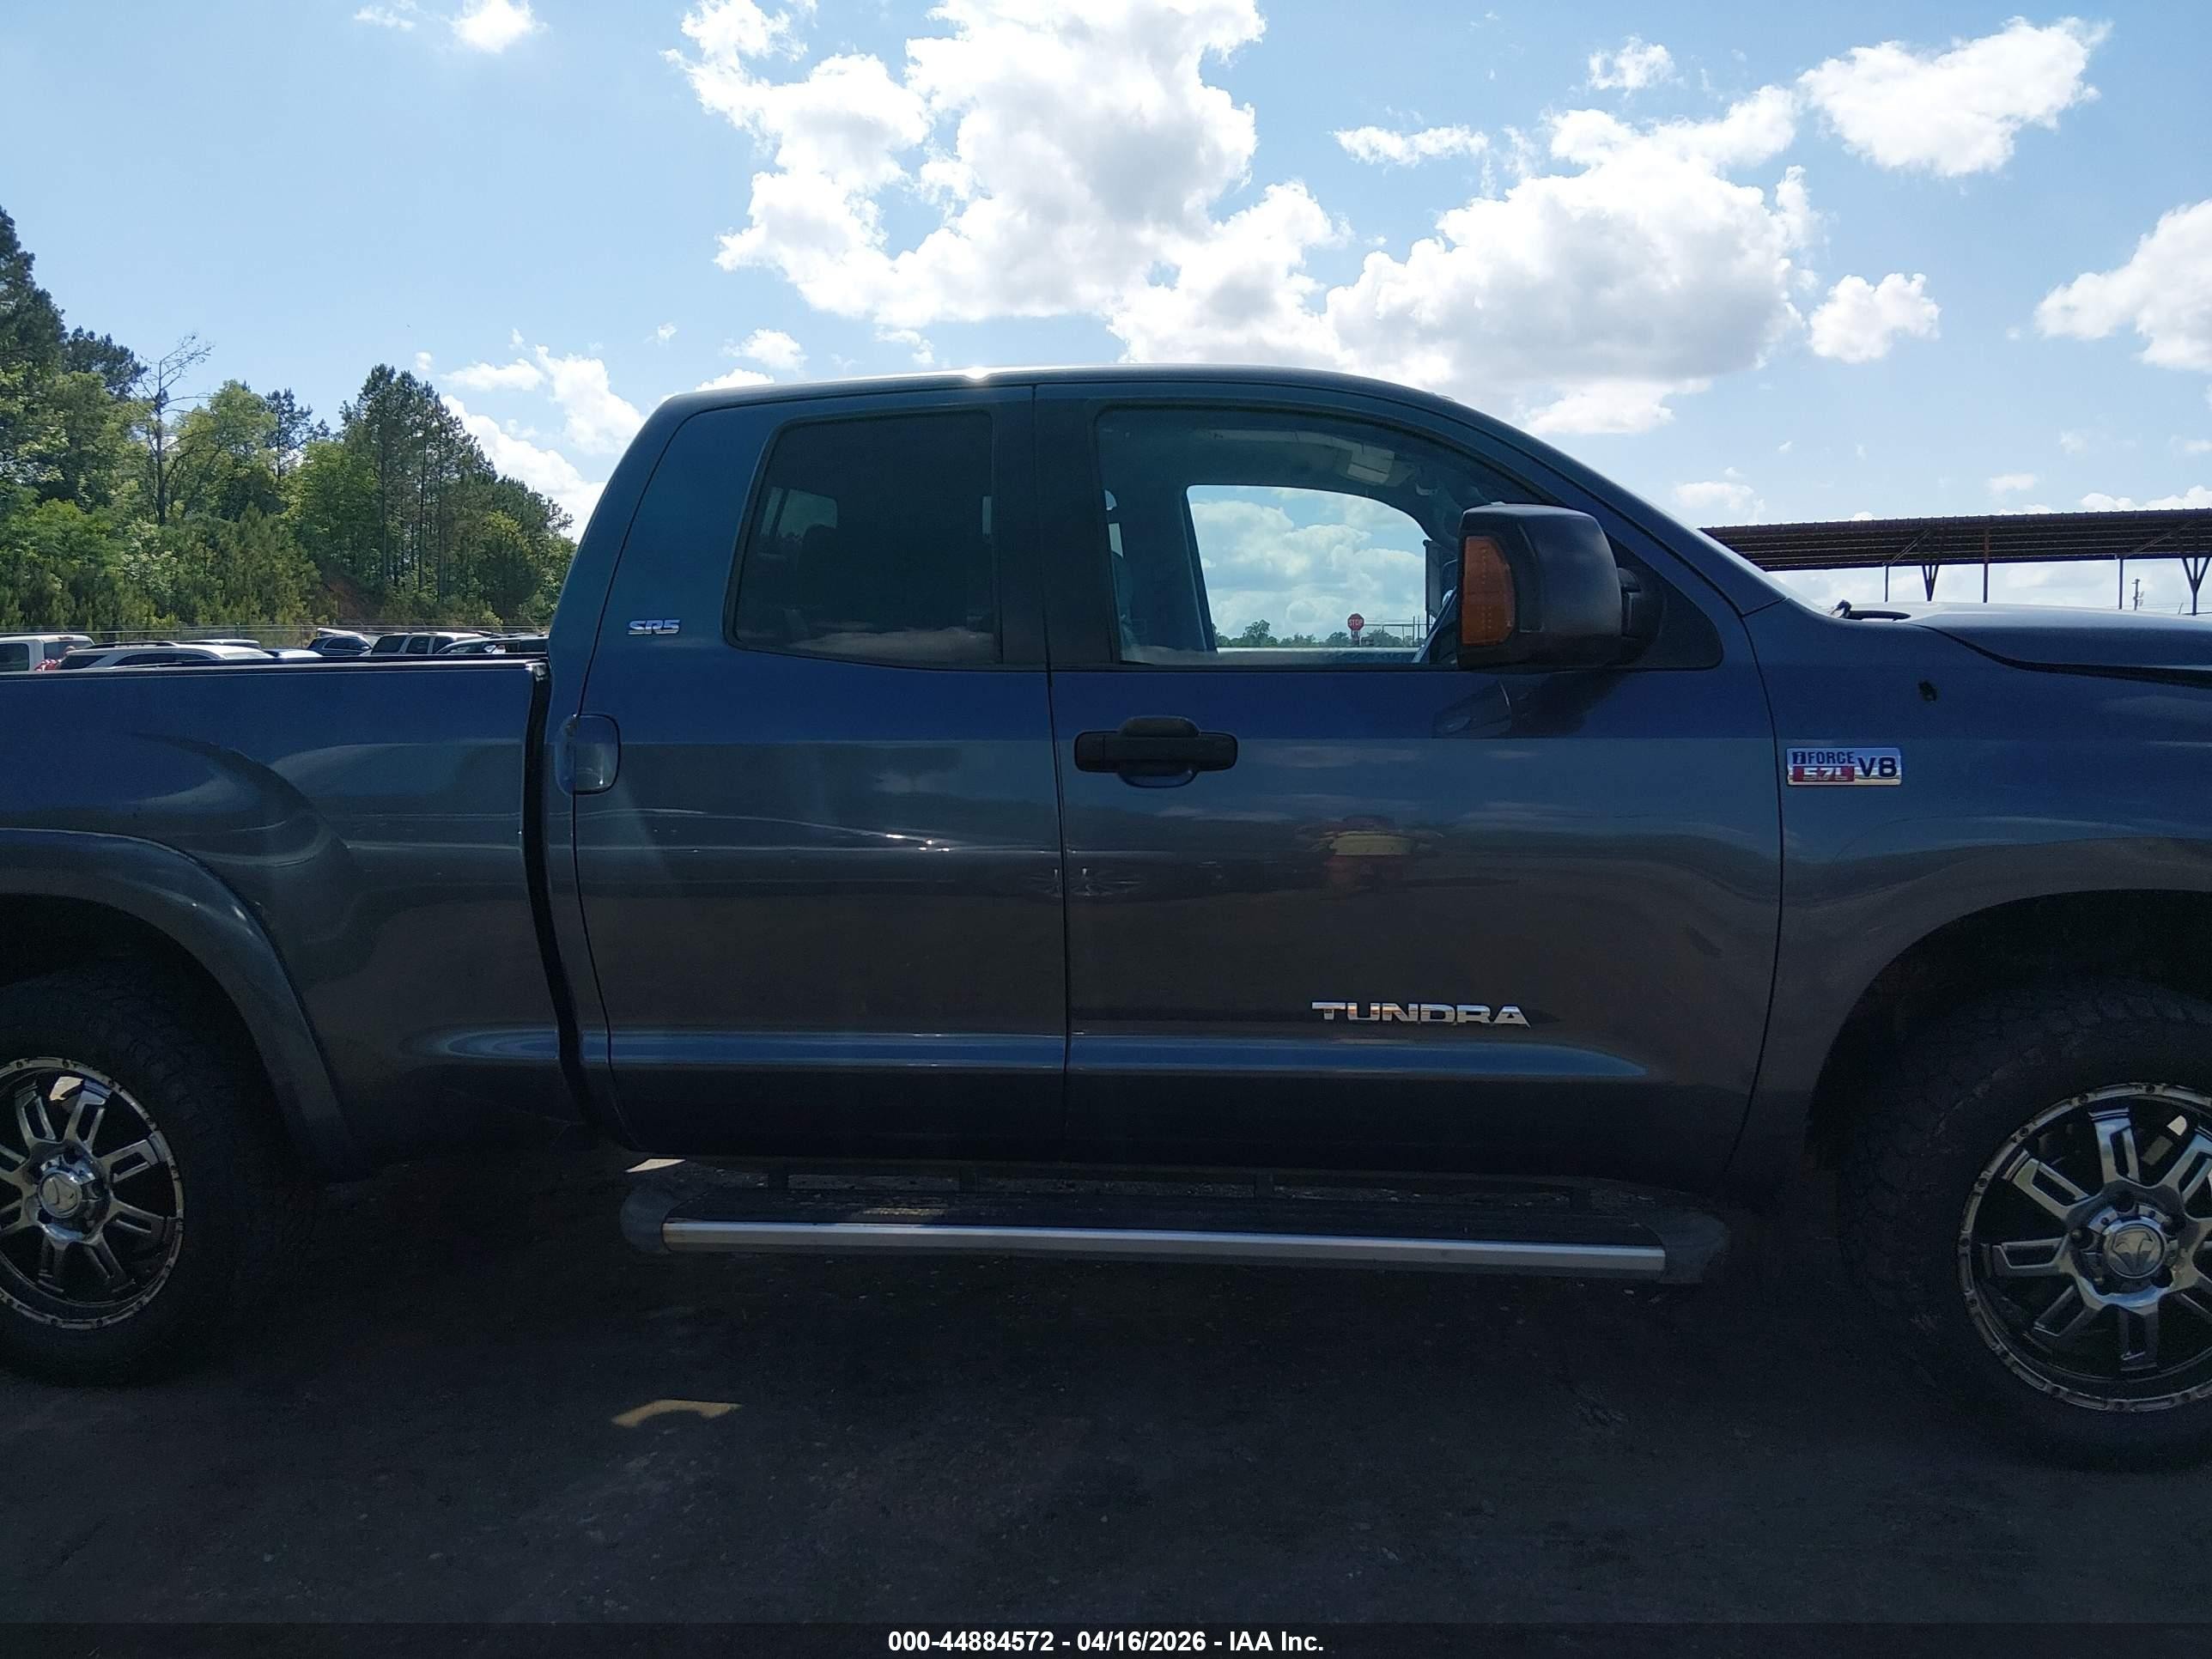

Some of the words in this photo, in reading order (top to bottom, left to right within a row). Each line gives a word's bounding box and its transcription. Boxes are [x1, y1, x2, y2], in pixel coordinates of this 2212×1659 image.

[628, 619, 680, 635] SR5
[1349, 618, 1364, 627] STOP
[1857, 757, 1898, 778] V8
[1311, 1001, 1531, 1029] TUNDRA
